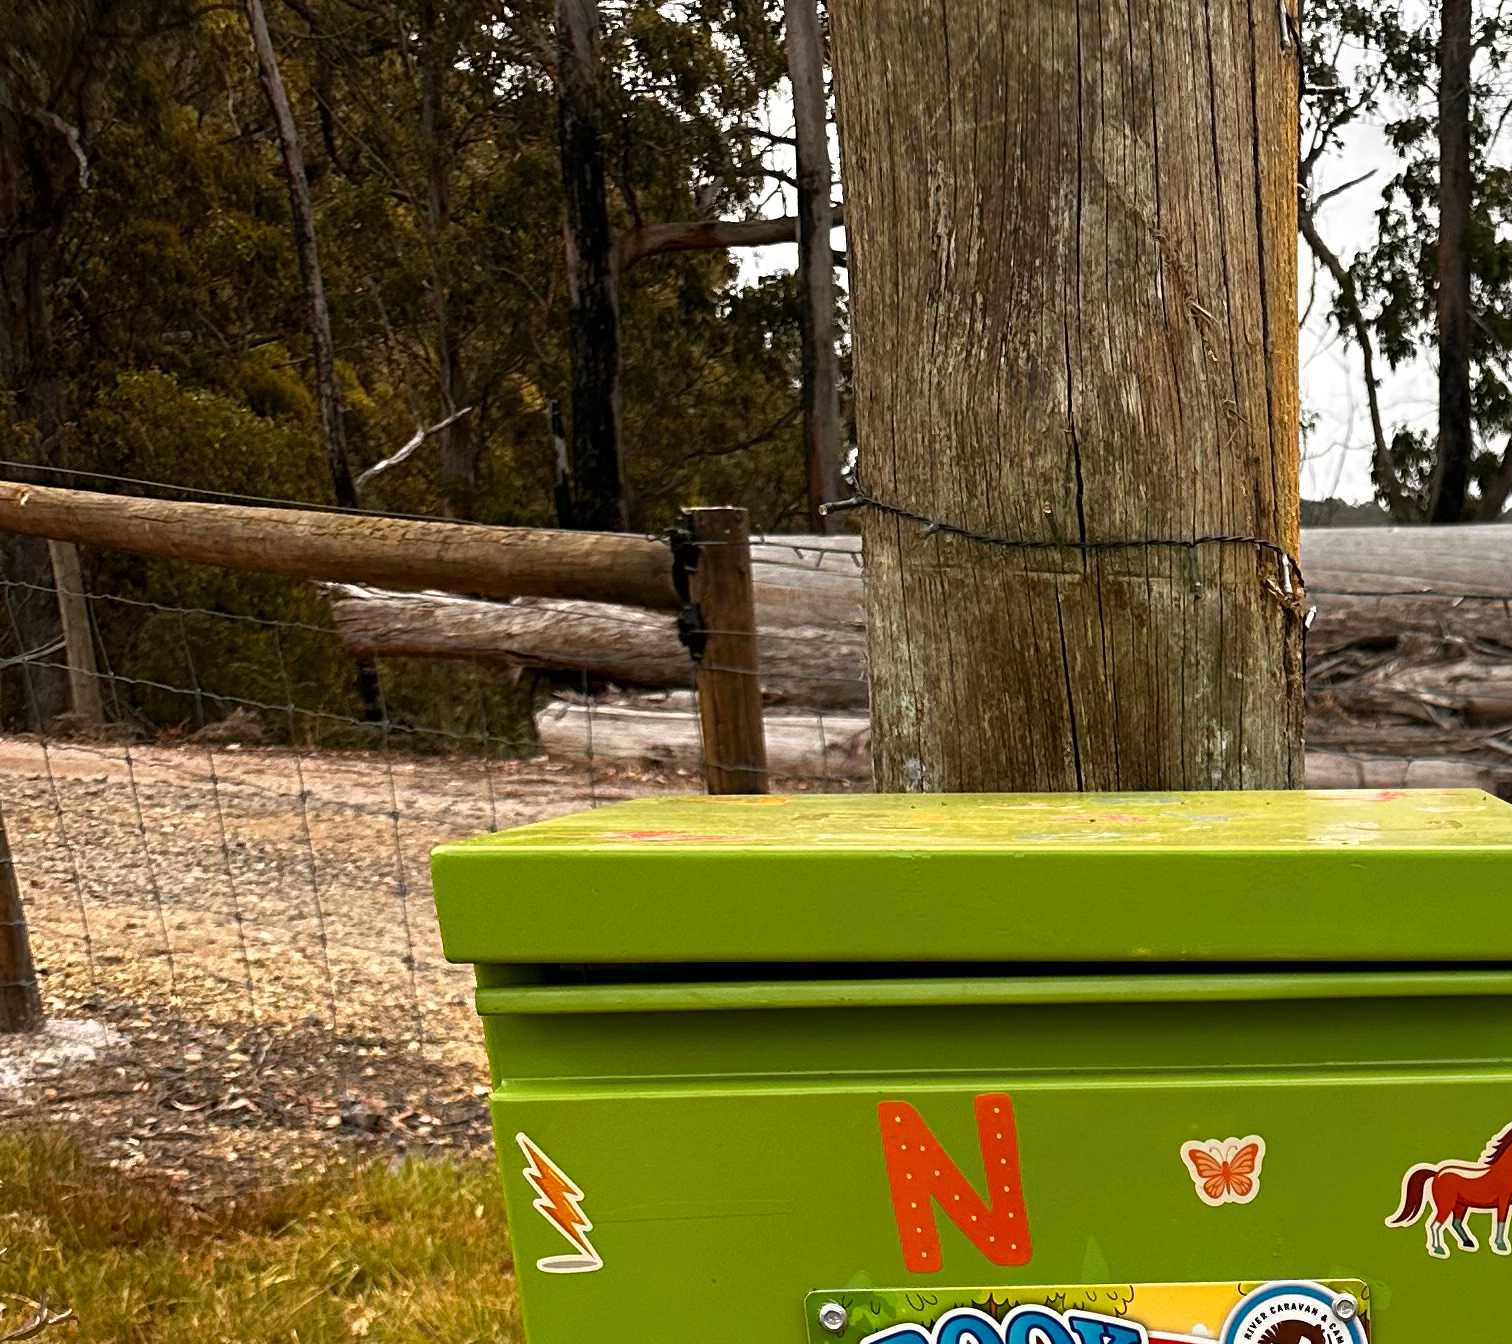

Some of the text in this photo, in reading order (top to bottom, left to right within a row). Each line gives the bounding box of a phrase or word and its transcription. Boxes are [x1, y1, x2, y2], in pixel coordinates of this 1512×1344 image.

[878, 1092, 1032, 1274] N
[1244, 1312, 1267, 1340] RIVER
[1270, 1303, 1319, 1316] CARAVAN
